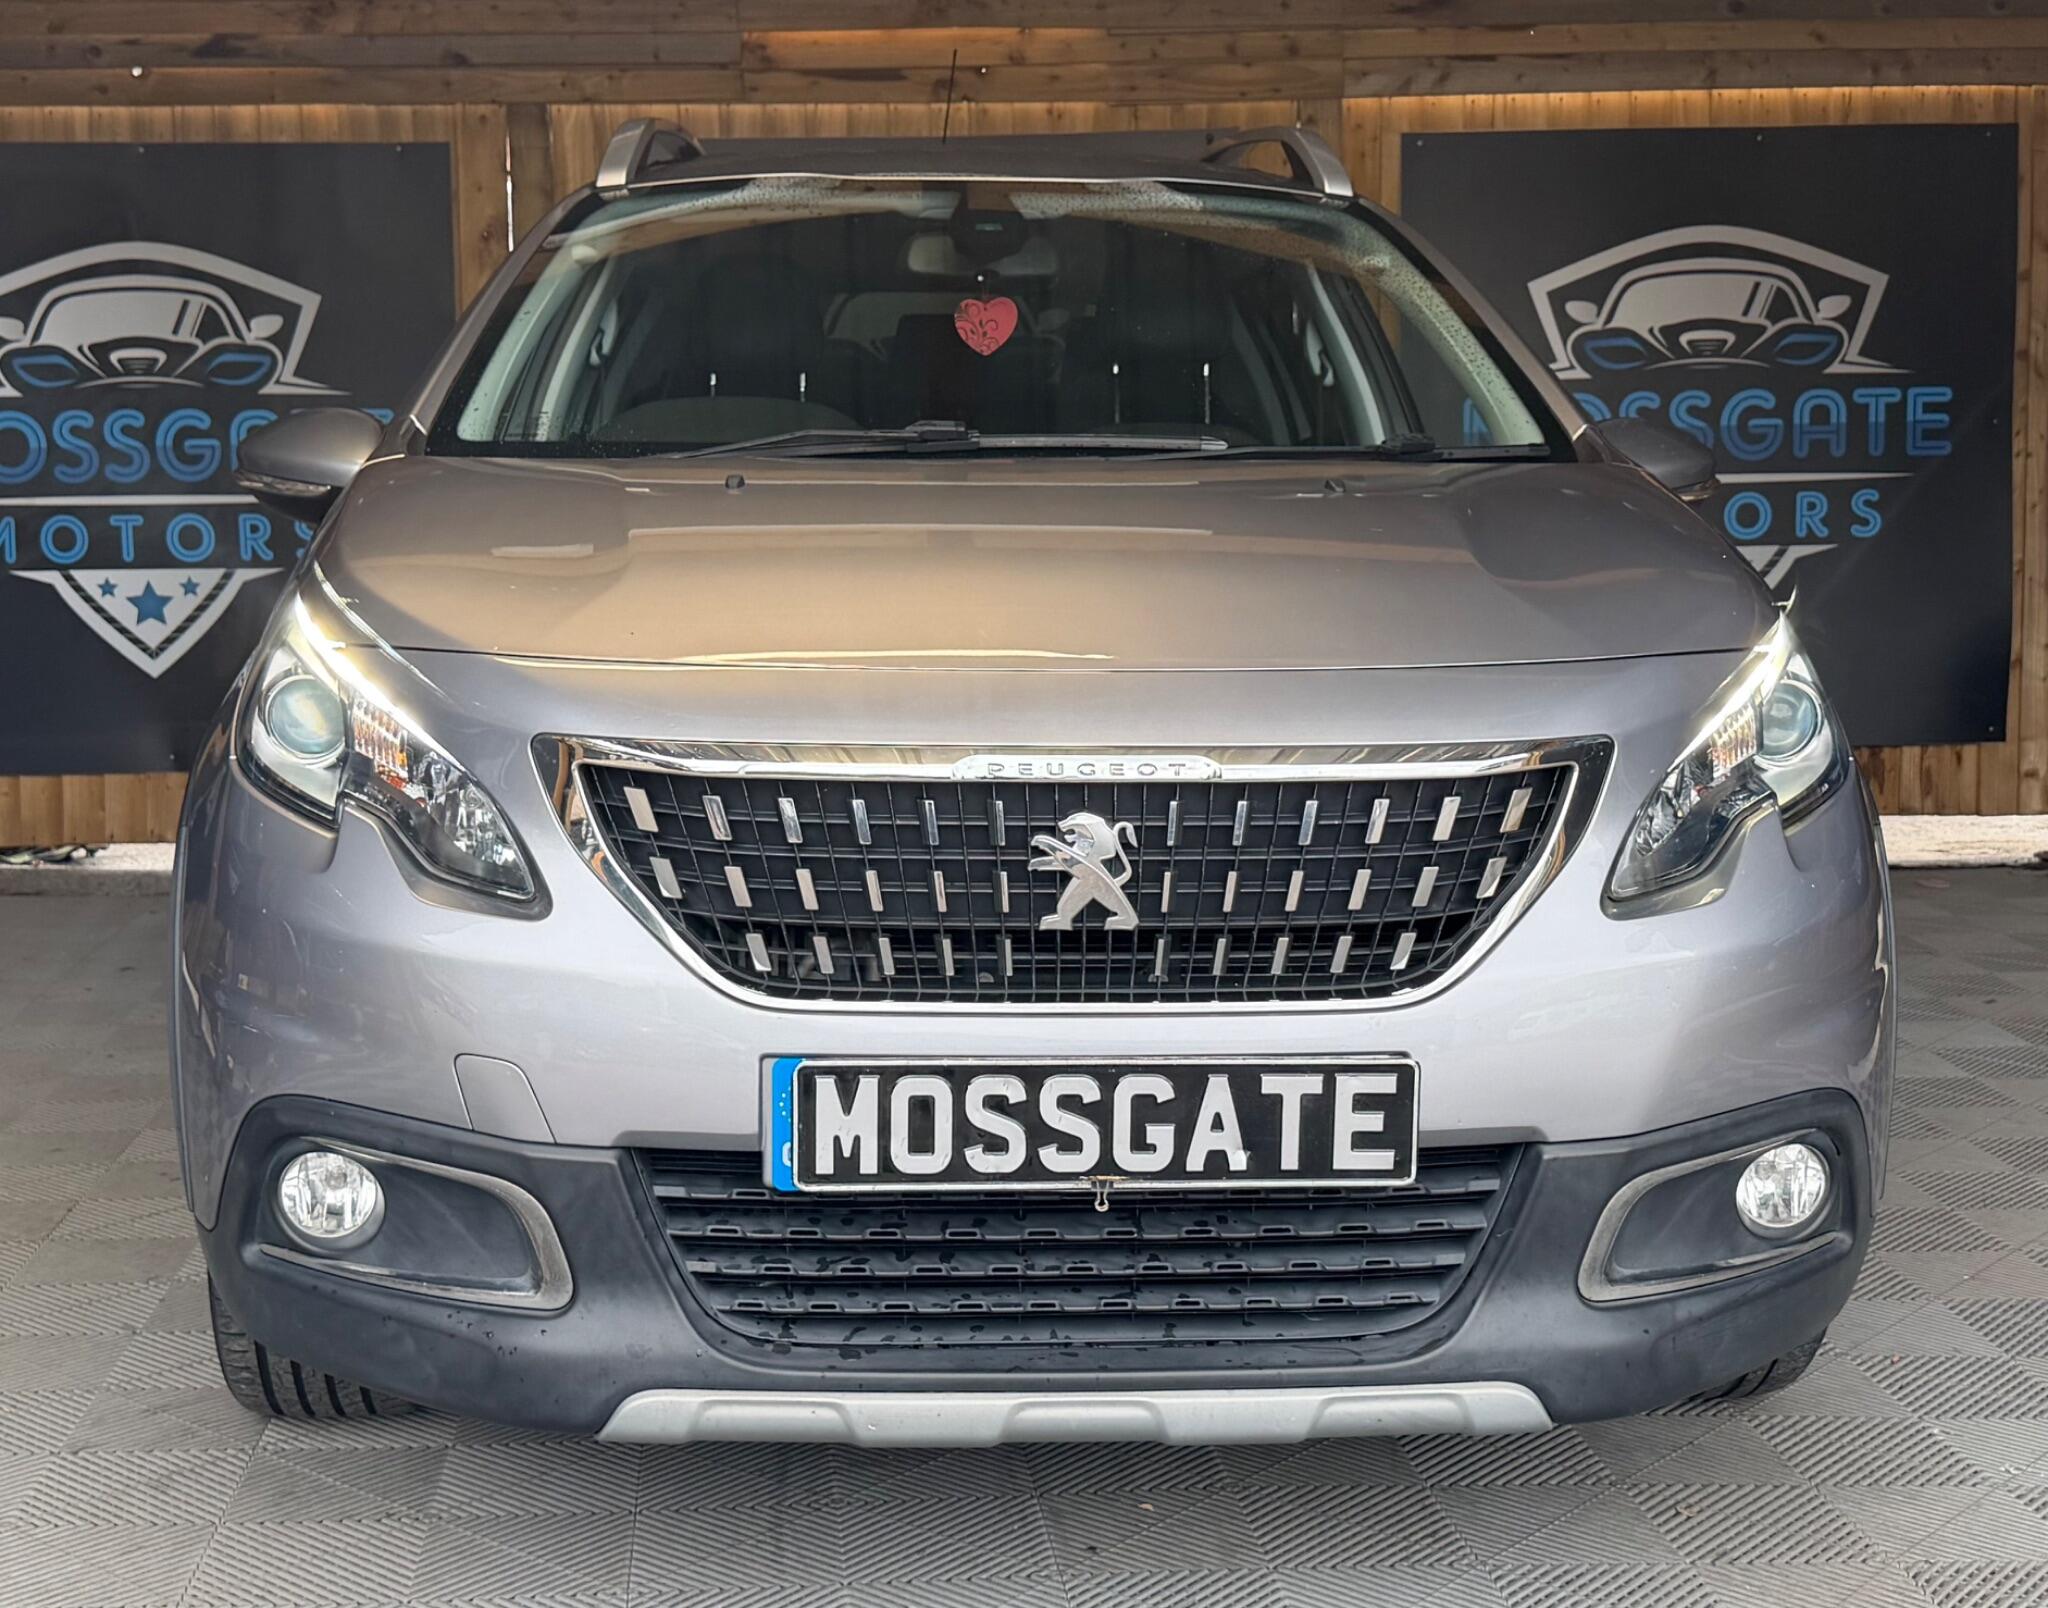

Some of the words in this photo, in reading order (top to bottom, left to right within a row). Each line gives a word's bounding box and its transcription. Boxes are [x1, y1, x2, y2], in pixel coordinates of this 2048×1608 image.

[1463, 386, 1953, 461] SGATE
[0, 513, 315, 564] OTOR
[1723, 489, 1883, 540] ORS
[987, 762, 1187, 777] PEUGEOT
[814, 1073, 1398, 1176] MOSSGATE
